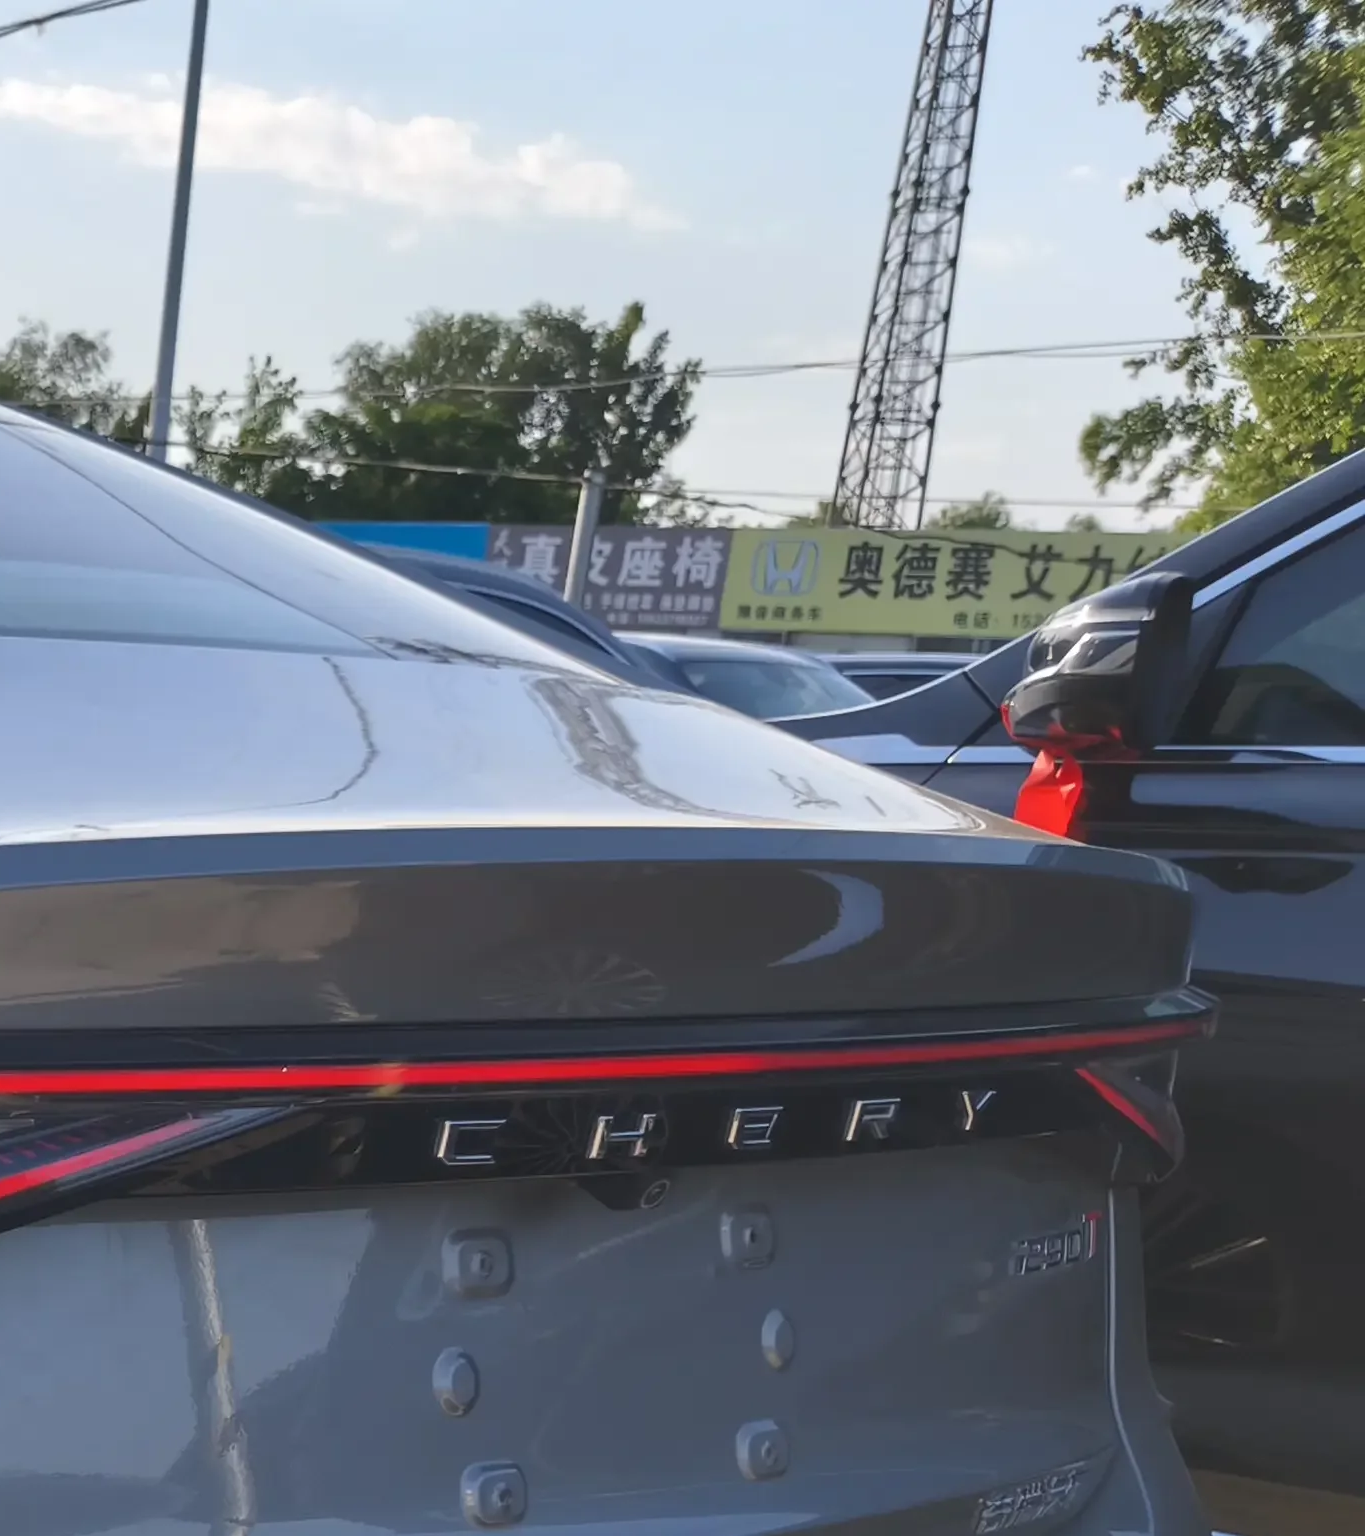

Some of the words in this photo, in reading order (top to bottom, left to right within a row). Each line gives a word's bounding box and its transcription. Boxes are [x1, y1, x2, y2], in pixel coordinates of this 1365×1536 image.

[838, 541, 996, 600] 奥德赛
[434, 1090, 998, 1165] CHERY
[1009, 1211, 1103, 1276] 290T
